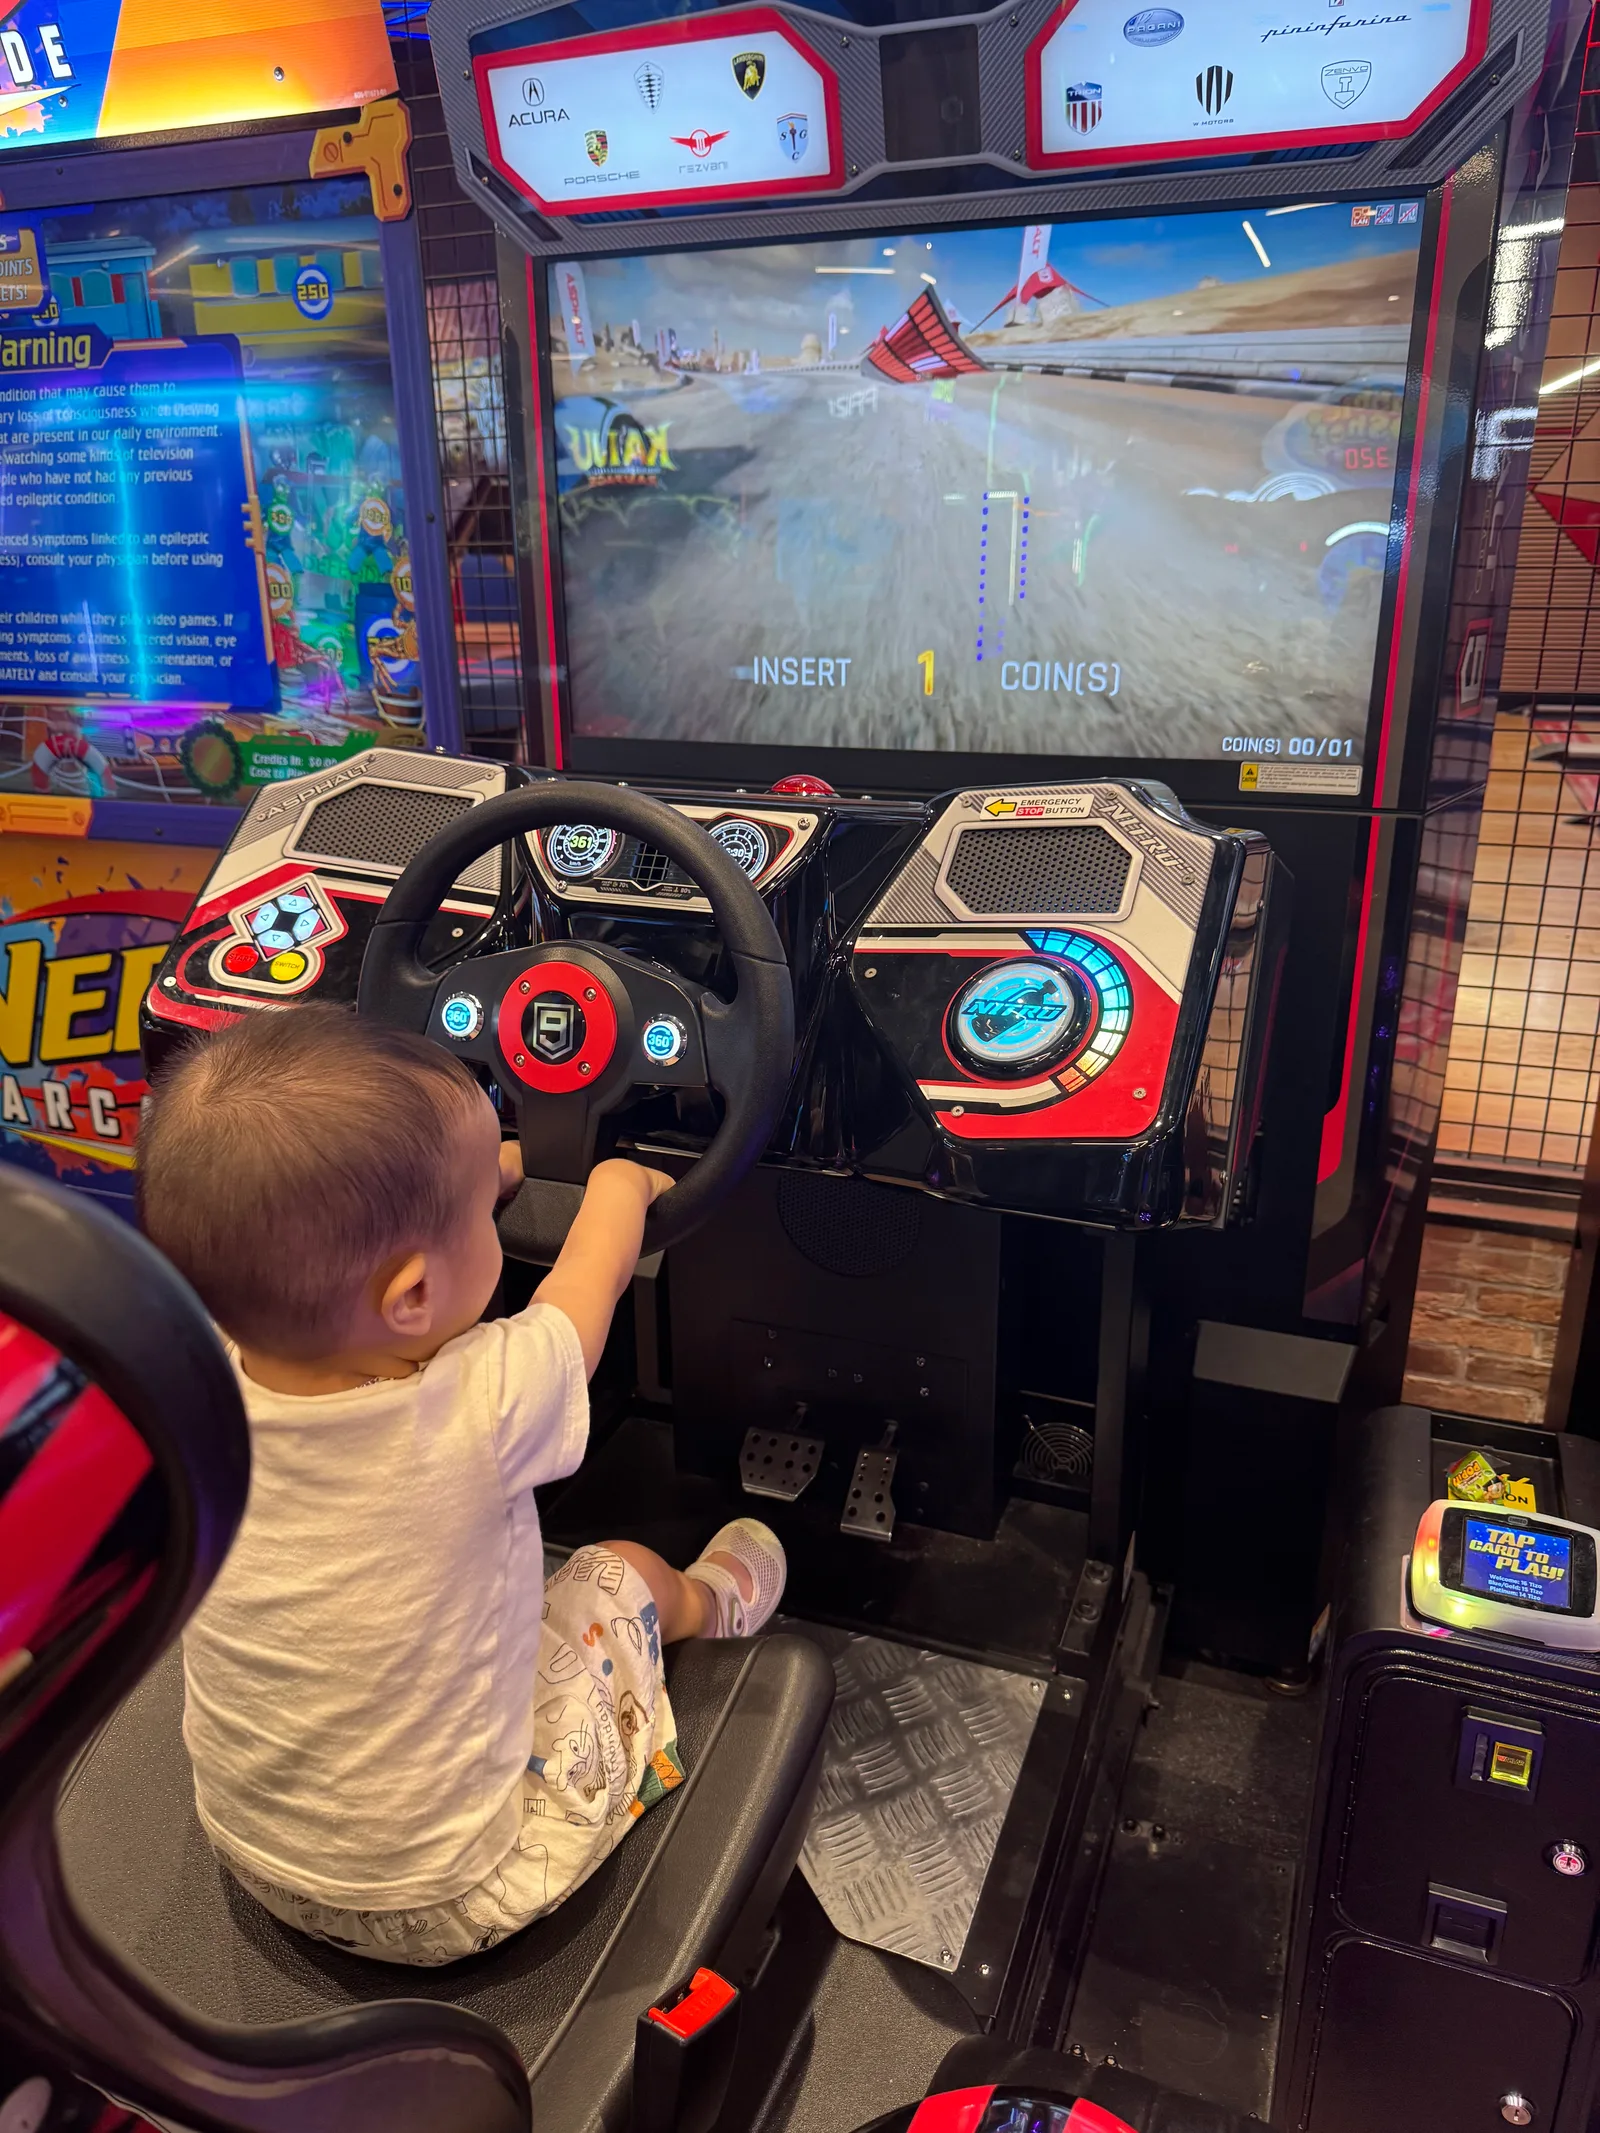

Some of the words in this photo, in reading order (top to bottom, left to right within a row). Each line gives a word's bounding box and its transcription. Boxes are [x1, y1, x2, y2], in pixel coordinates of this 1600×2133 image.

[1127, 21, 1181, 33] PAGANI
[1324, 65, 1369, 77] ZENVO
[1067, 86, 1101, 99] TRION
[508, 108, 570, 128] ACURA
[563, 170, 641, 186] PORSCHE
[1353, 218, 1369, 226] LAN
[298, 283, 328, 300] 250
[0, 331, 91, 369] arning
[39, 386, 62, 400] that
[66, 387, 88, 401] may
[93, 385, 125, 397] cause
[130, 383, 160, 396] them
[163, 382, 176, 395] to
[18, 410, 39, 423] loss
[11, 433, 29, 444] are
[33, 430, 75, 446] present
[77, 429, 88, 441] in
[91, 430, 110, 441] our
[114, 427, 141, 442] daily
[145, 425, 223, 440] environment.
[4, 450, 54, 466] watching
[57, 452, 86, 464] some
[90, 448, 120, 463] kinds
[138, 448, 194, 461] television
[19, 471, 42, 485] who
[45, 471, 71, 484] have
[74, 471, 92, 484] not
[95, 469, 116, 483] had
[143, 468, 193, 485] previous
[16, 492, 62, 507] epileptic
[31, 534, 88, 549] symptoms
[91, 532, 123, 545] linked
[143, 534, 157, 545] an
[159, 532, 209, 546] epileptic
[26, 553, 65, 566] consult
[68, 554, 93, 568] your
[152, 553, 189, 566] before
[192, 553, 224, 567] using
[15, 612, 58, 625] children
[92, 613, 116, 627] they
[215, 636, 237, 649] eye
[34, 650, 56, 663] loss
[58, 650, 70, 663] of
[219, 655, 233, 667] or
[38, 669, 57, 682] and
[101, 671, 126, 685] your
[753, 656, 851, 687] INSERT
[917, 650, 936, 696] 1
[1000, 661, 1121, 697] COIN(S)
[1222, 737, 1281, 755] COIN(S)
[1289, 737, 1353, 757] 00/01
[252, 752, 289, 766] Credits
[249, 766, 271, 779] Cost
[273, 767, 286, 779] to
[267, 760, 371, 819] ASPHALT
[1020, 798, 1082, 806] EMERGENCY
[1017, 807, 1044, 816] STOP
[1045, 806, 1085, 815] BUTTON
[569, 835, 593, 849] 361
[1099, 802, 1182, 868] NITRO
[229, 953, 254, 962] START
[275, 961, 301, 970] SWITCH
[963, 998, 1067, 1022] NITRO
[3, 1075, 150, 1137] ARC
[1486, 1528, 1535, 1548] TAP
[1469, 1539, 1520, 1558] CARD
[1524, 1550, 1549, 1564] TO
[1495, 1556, 1565, 1580] PLAY!
[1489, 1573, 1520, 1584] Welcome:
